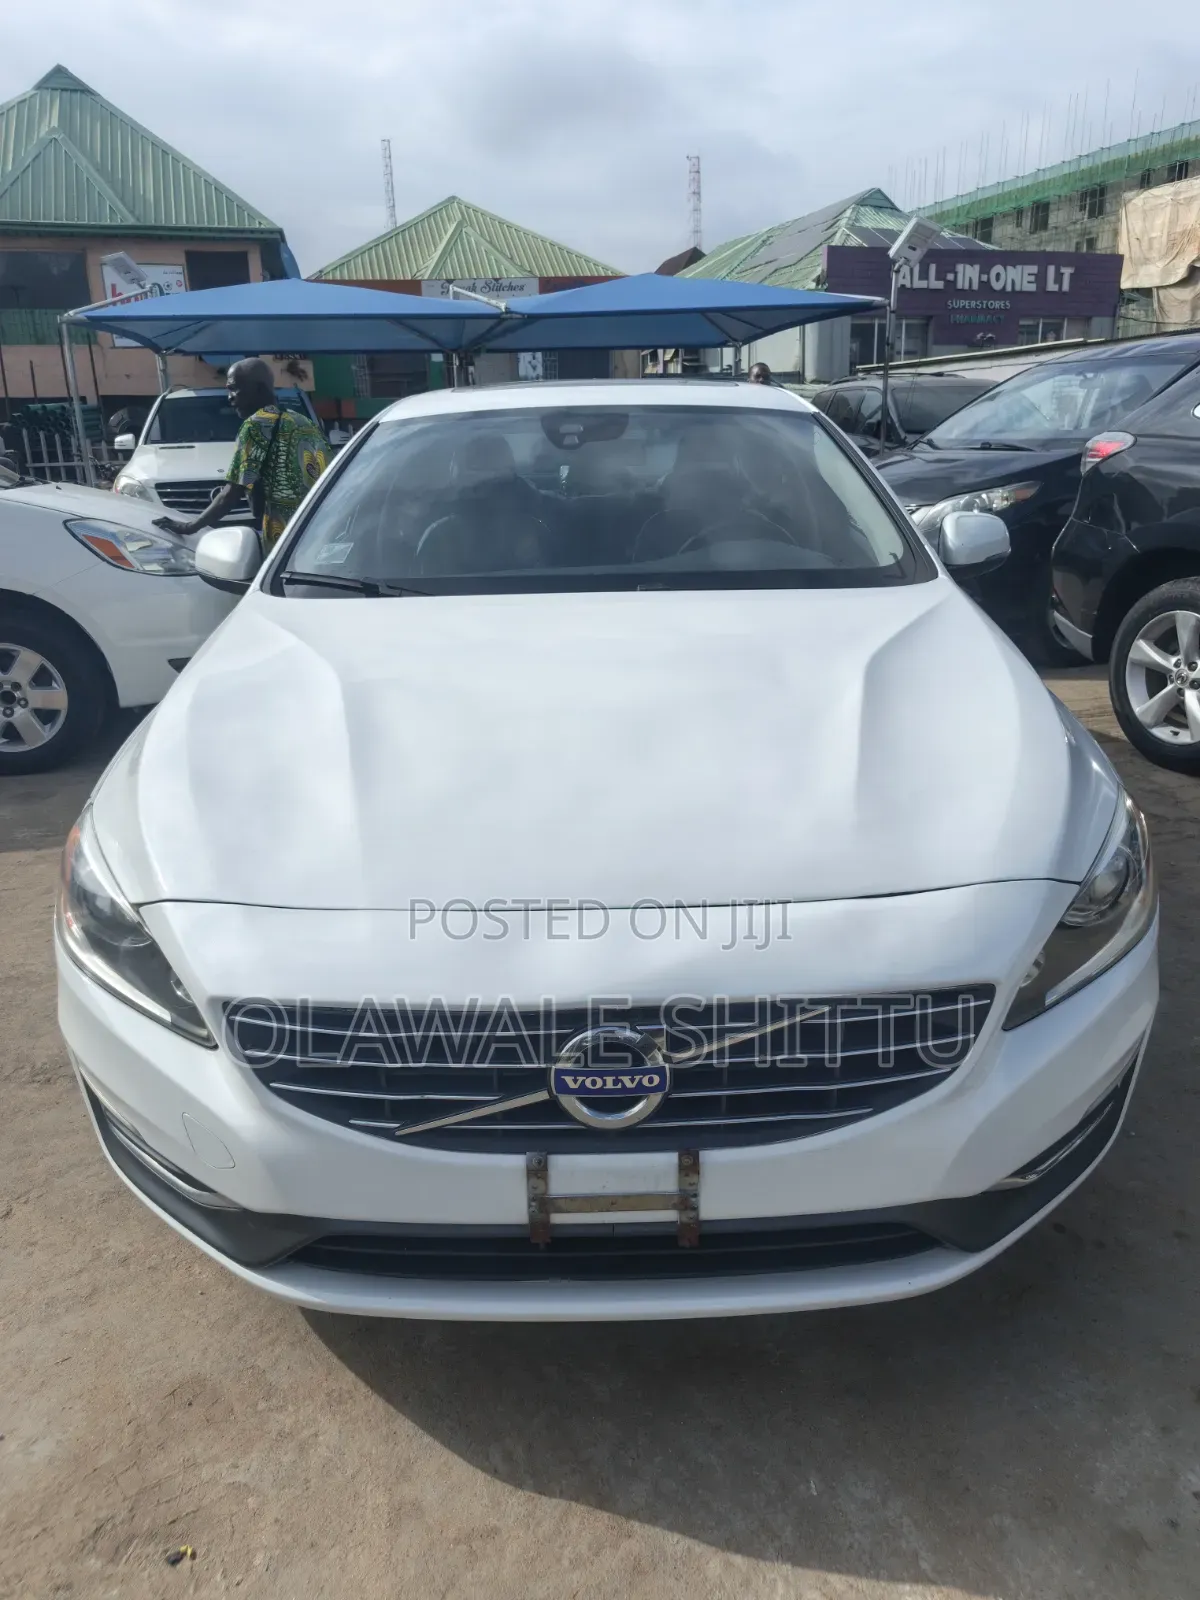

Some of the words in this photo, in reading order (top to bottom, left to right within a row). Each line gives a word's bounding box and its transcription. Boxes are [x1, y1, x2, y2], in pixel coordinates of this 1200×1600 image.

[897, 263, 1038, 292] ALL-IN-ONE
[1046, 265, 1075, 292] LT
[480, 279, 525, 294] Stitches
[947, 299, 1011, 310] SUPERSTORES
[561, 1074, 660, 1090] VOLVO
